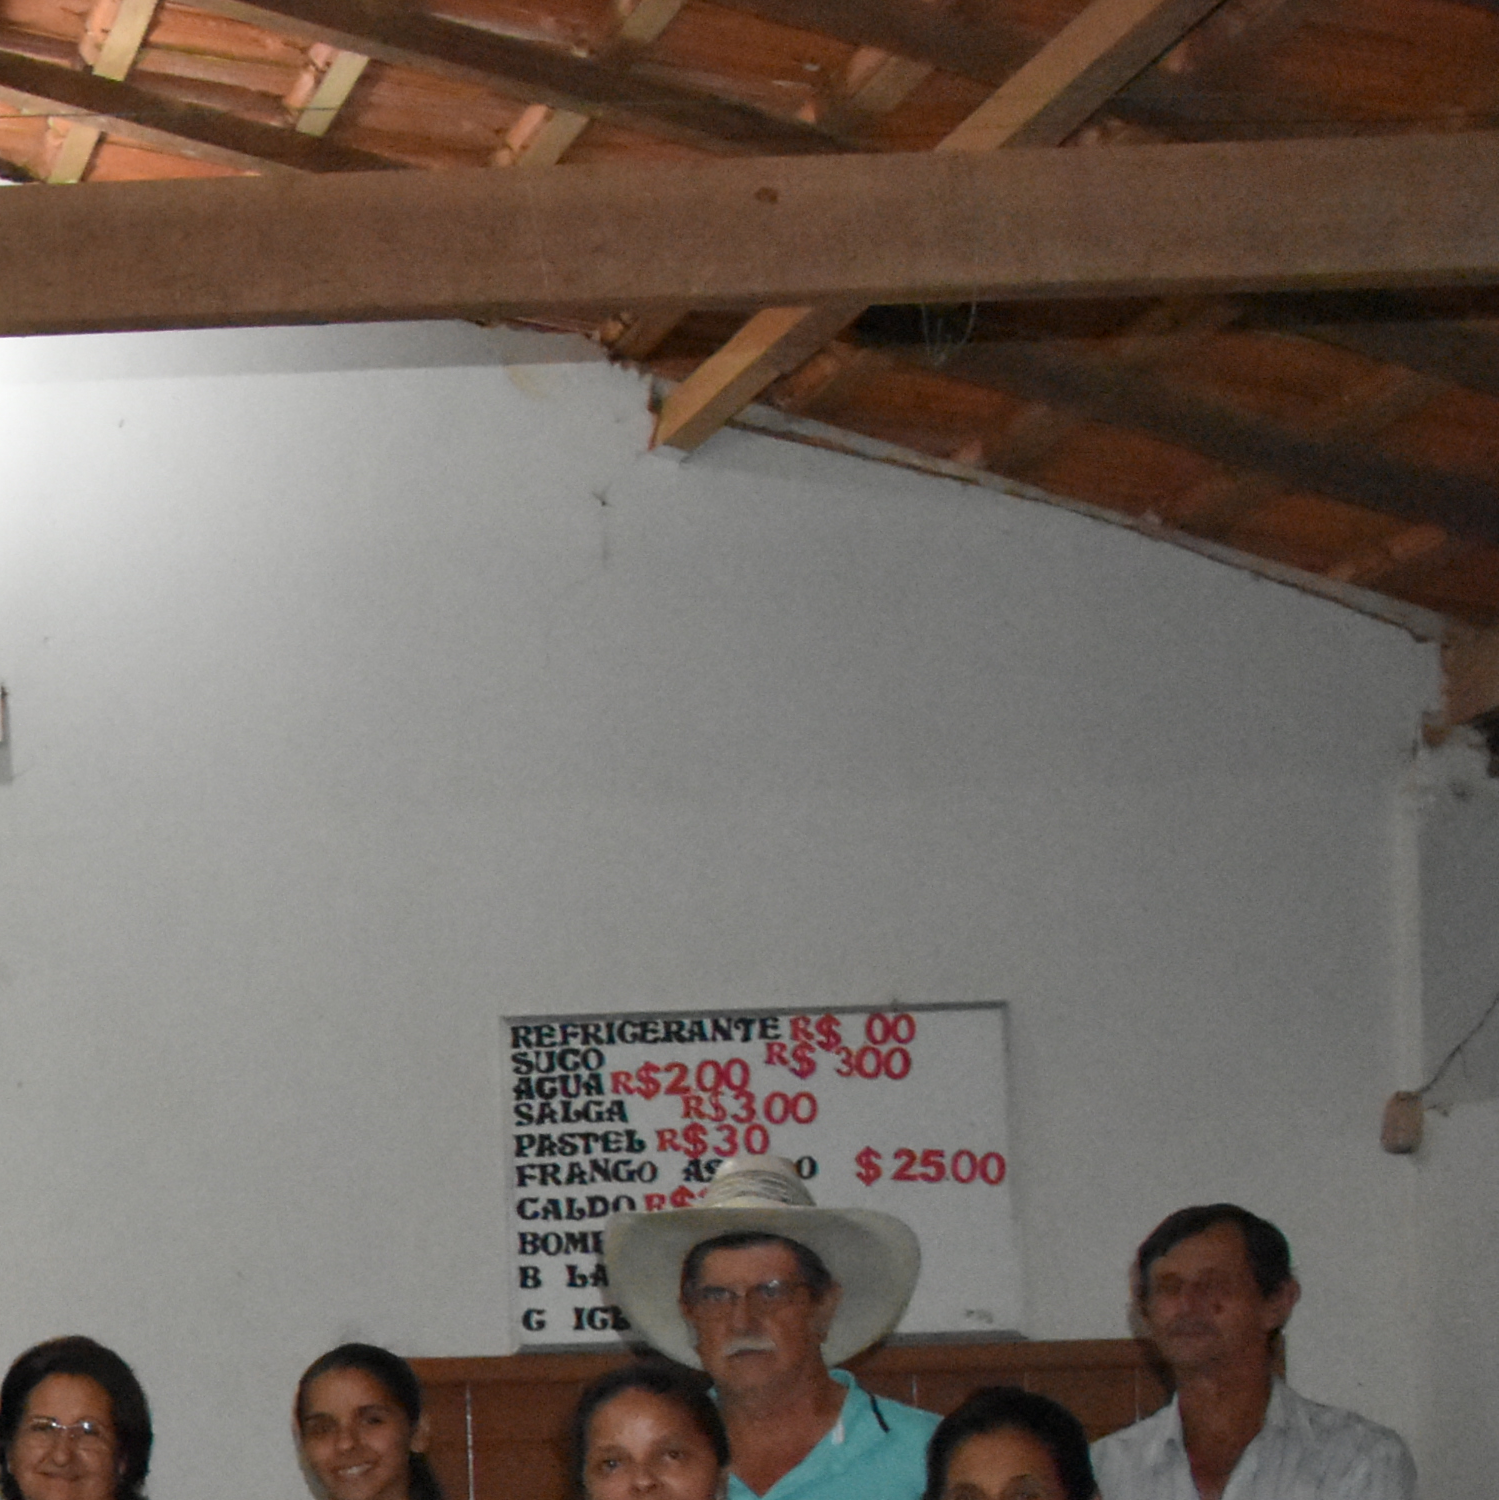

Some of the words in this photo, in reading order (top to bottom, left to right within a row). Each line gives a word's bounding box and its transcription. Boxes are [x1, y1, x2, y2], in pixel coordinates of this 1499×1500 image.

[513, 1100, 629, 1127] SALGA
[514, 1129, 647, 1158] PASTEL
[515, 1158, 658, 1188] FRANGO
[516, 1194, 636, 1221] CALDO
